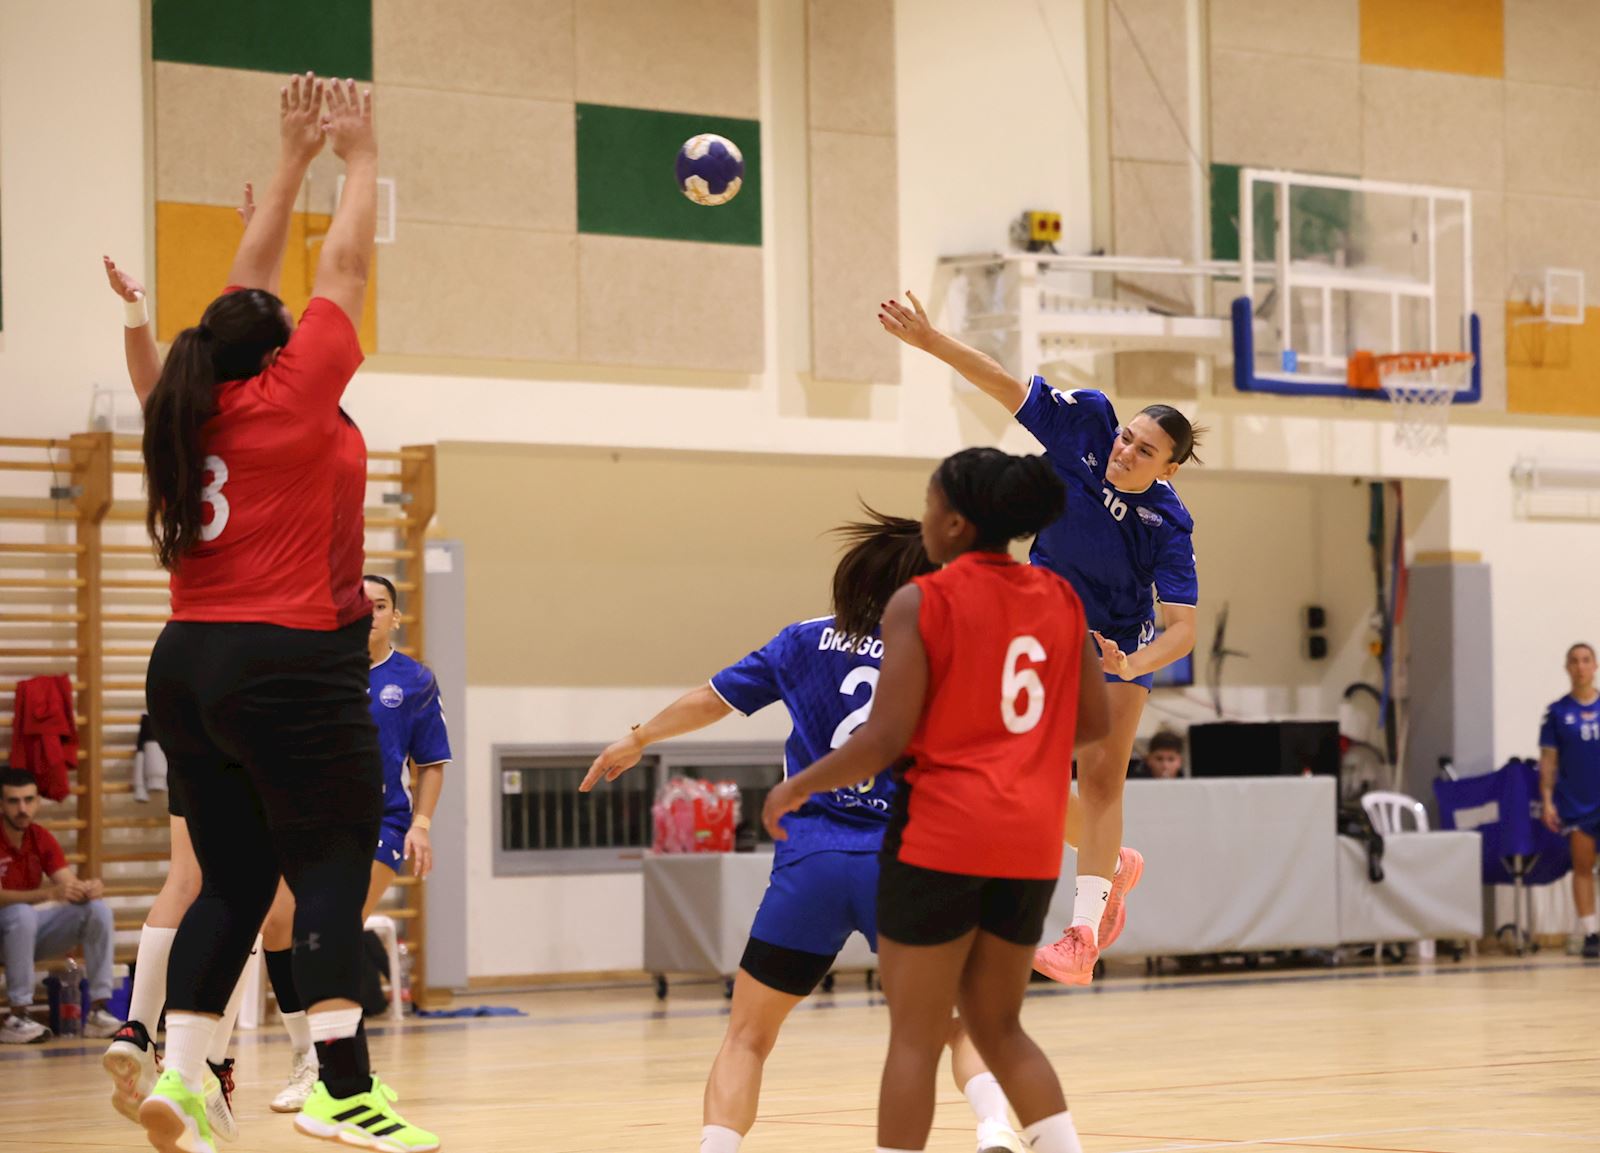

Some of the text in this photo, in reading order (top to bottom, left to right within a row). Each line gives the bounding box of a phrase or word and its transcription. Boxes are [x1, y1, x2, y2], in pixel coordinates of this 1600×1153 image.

[1102, 487, 1128, 522] 16
[818, 627, 884, 660] DRAGO
[1000, 634, 1046, 735] 6
